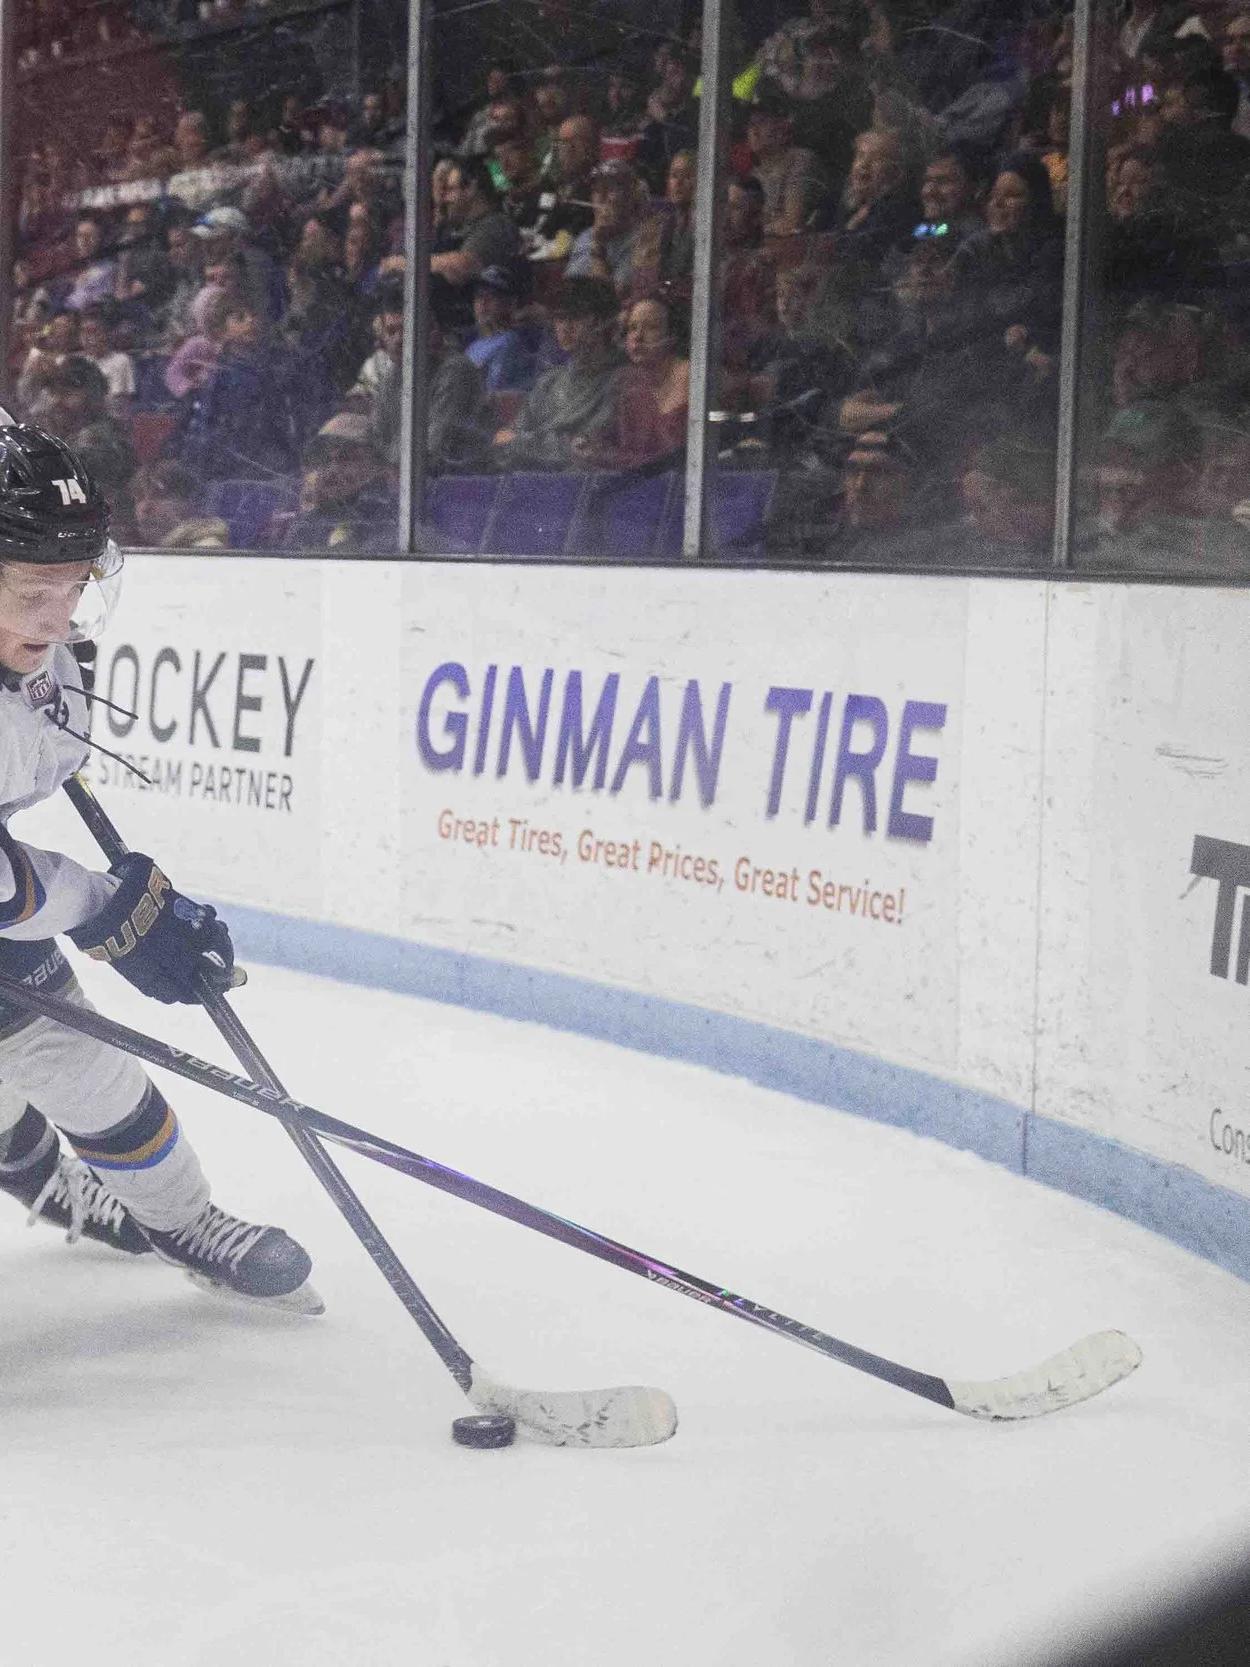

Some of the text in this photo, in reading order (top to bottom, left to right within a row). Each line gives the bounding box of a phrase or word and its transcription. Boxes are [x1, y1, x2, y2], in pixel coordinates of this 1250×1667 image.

[88, 644, 315, 758] OCKEY
[417, 661, 948, 844] GINMAN TIRE
[99, 750, 183, 797] STREAM
[188, 759, 295, 813] PARTNER
[438, 808, 906, 925] Great Tires, Great Prices, Great Service!
